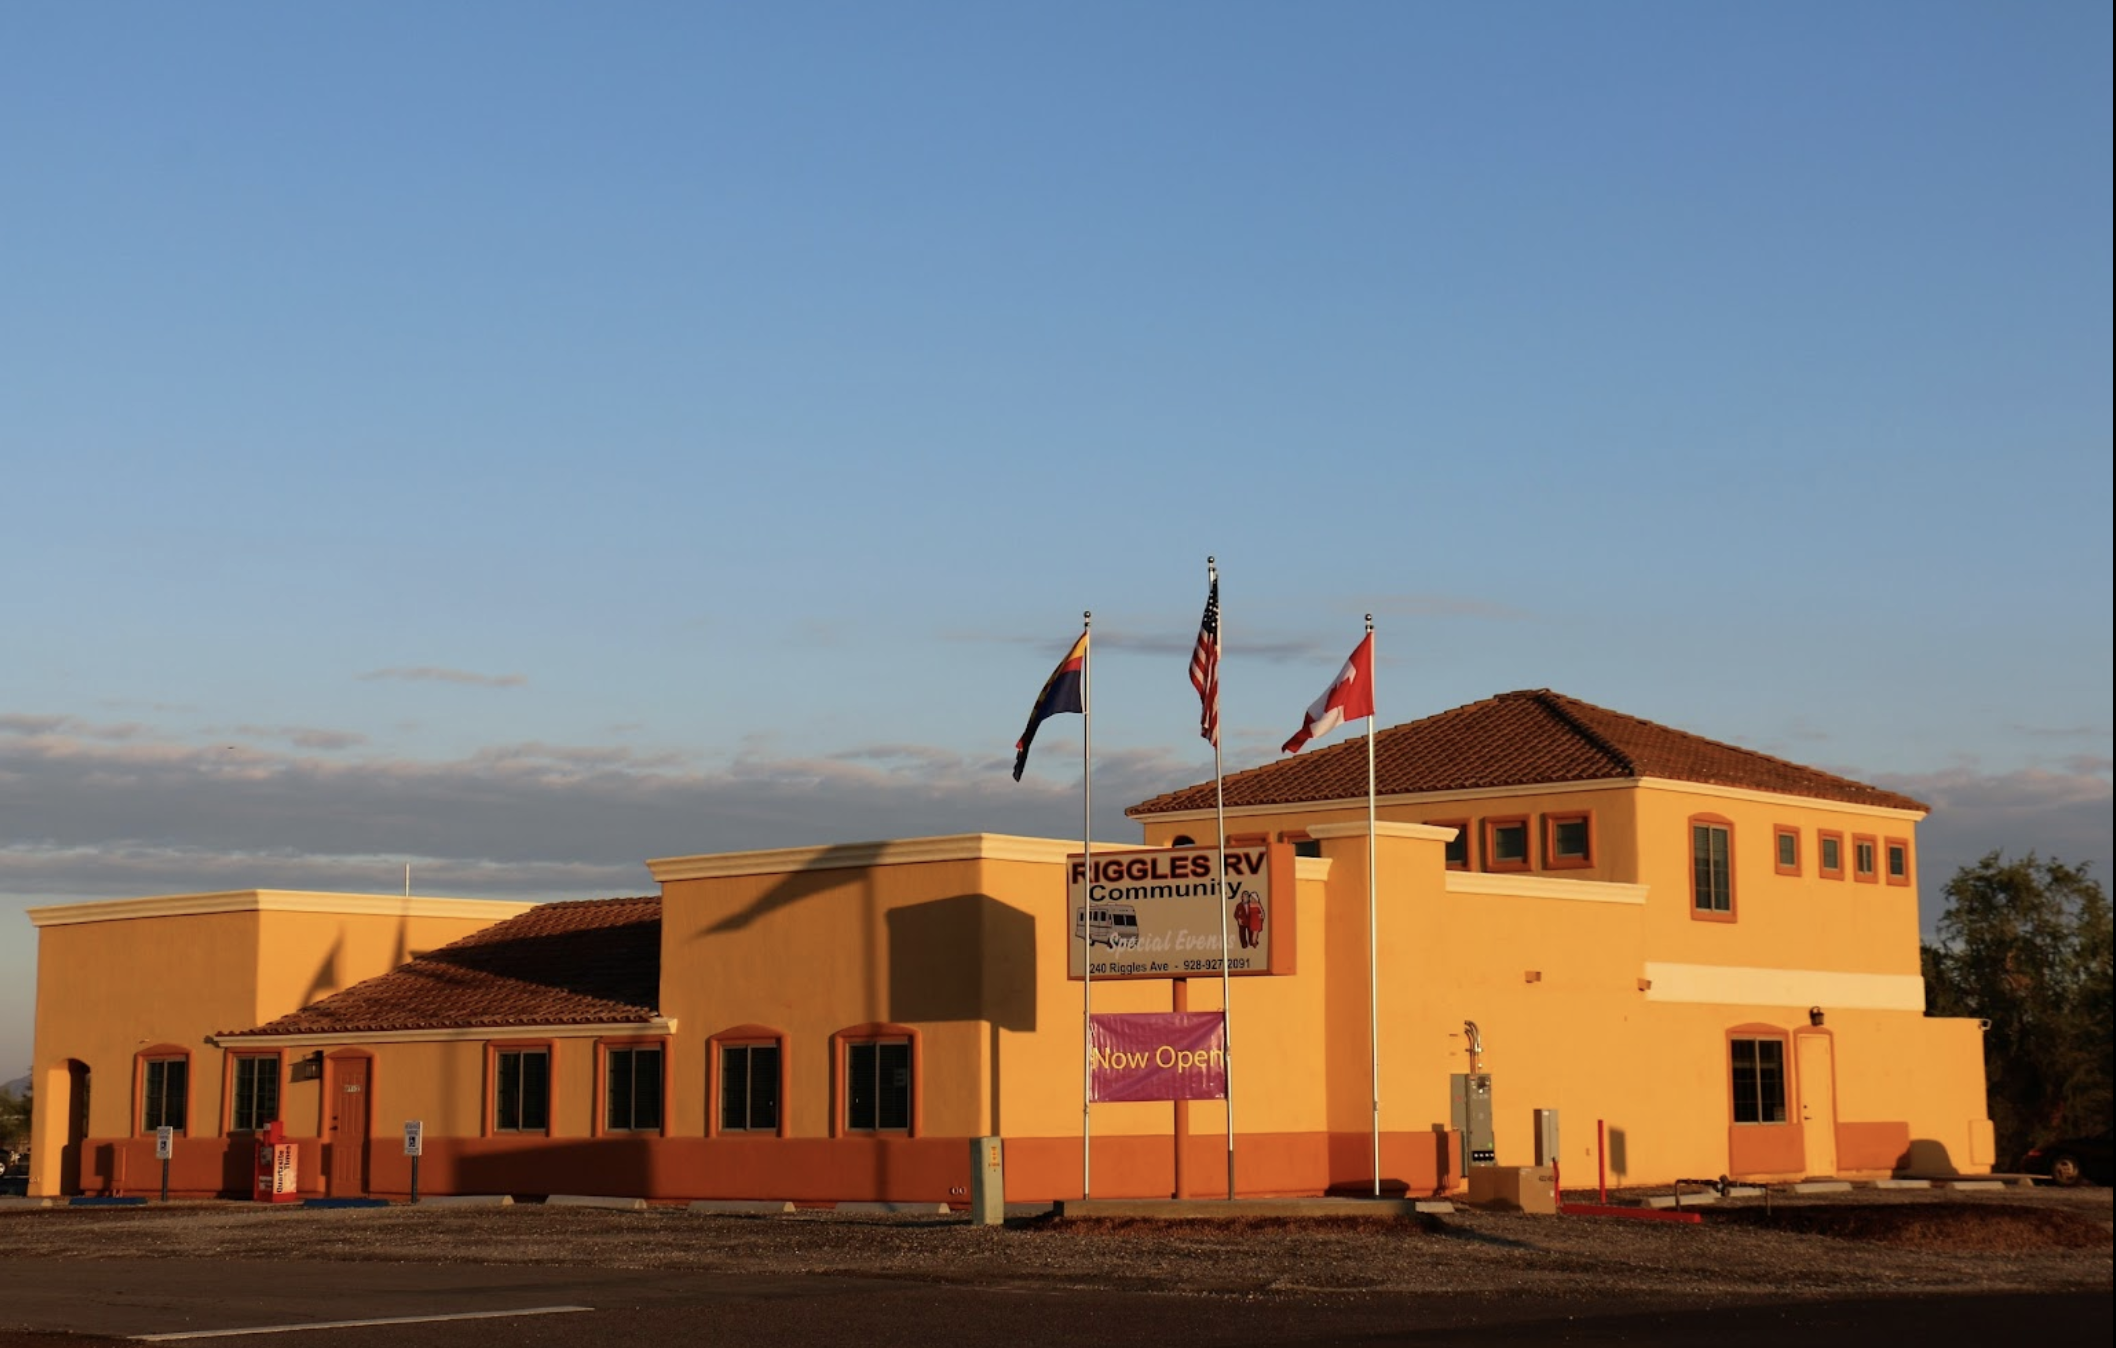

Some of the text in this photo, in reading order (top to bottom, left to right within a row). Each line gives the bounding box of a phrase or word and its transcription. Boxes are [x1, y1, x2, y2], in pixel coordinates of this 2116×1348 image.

[1072, 851, 1267, 884] RIGGLES RV
[1107, 929, 1236, 959] Special Evens
[1109, 961, 1147, 976] Riggles
[1150, 960, 1169, 972] Ave
[1183, 957, 1251, 971] 928-9272091
[1091, 1045, 1224, 1073] Now Open
